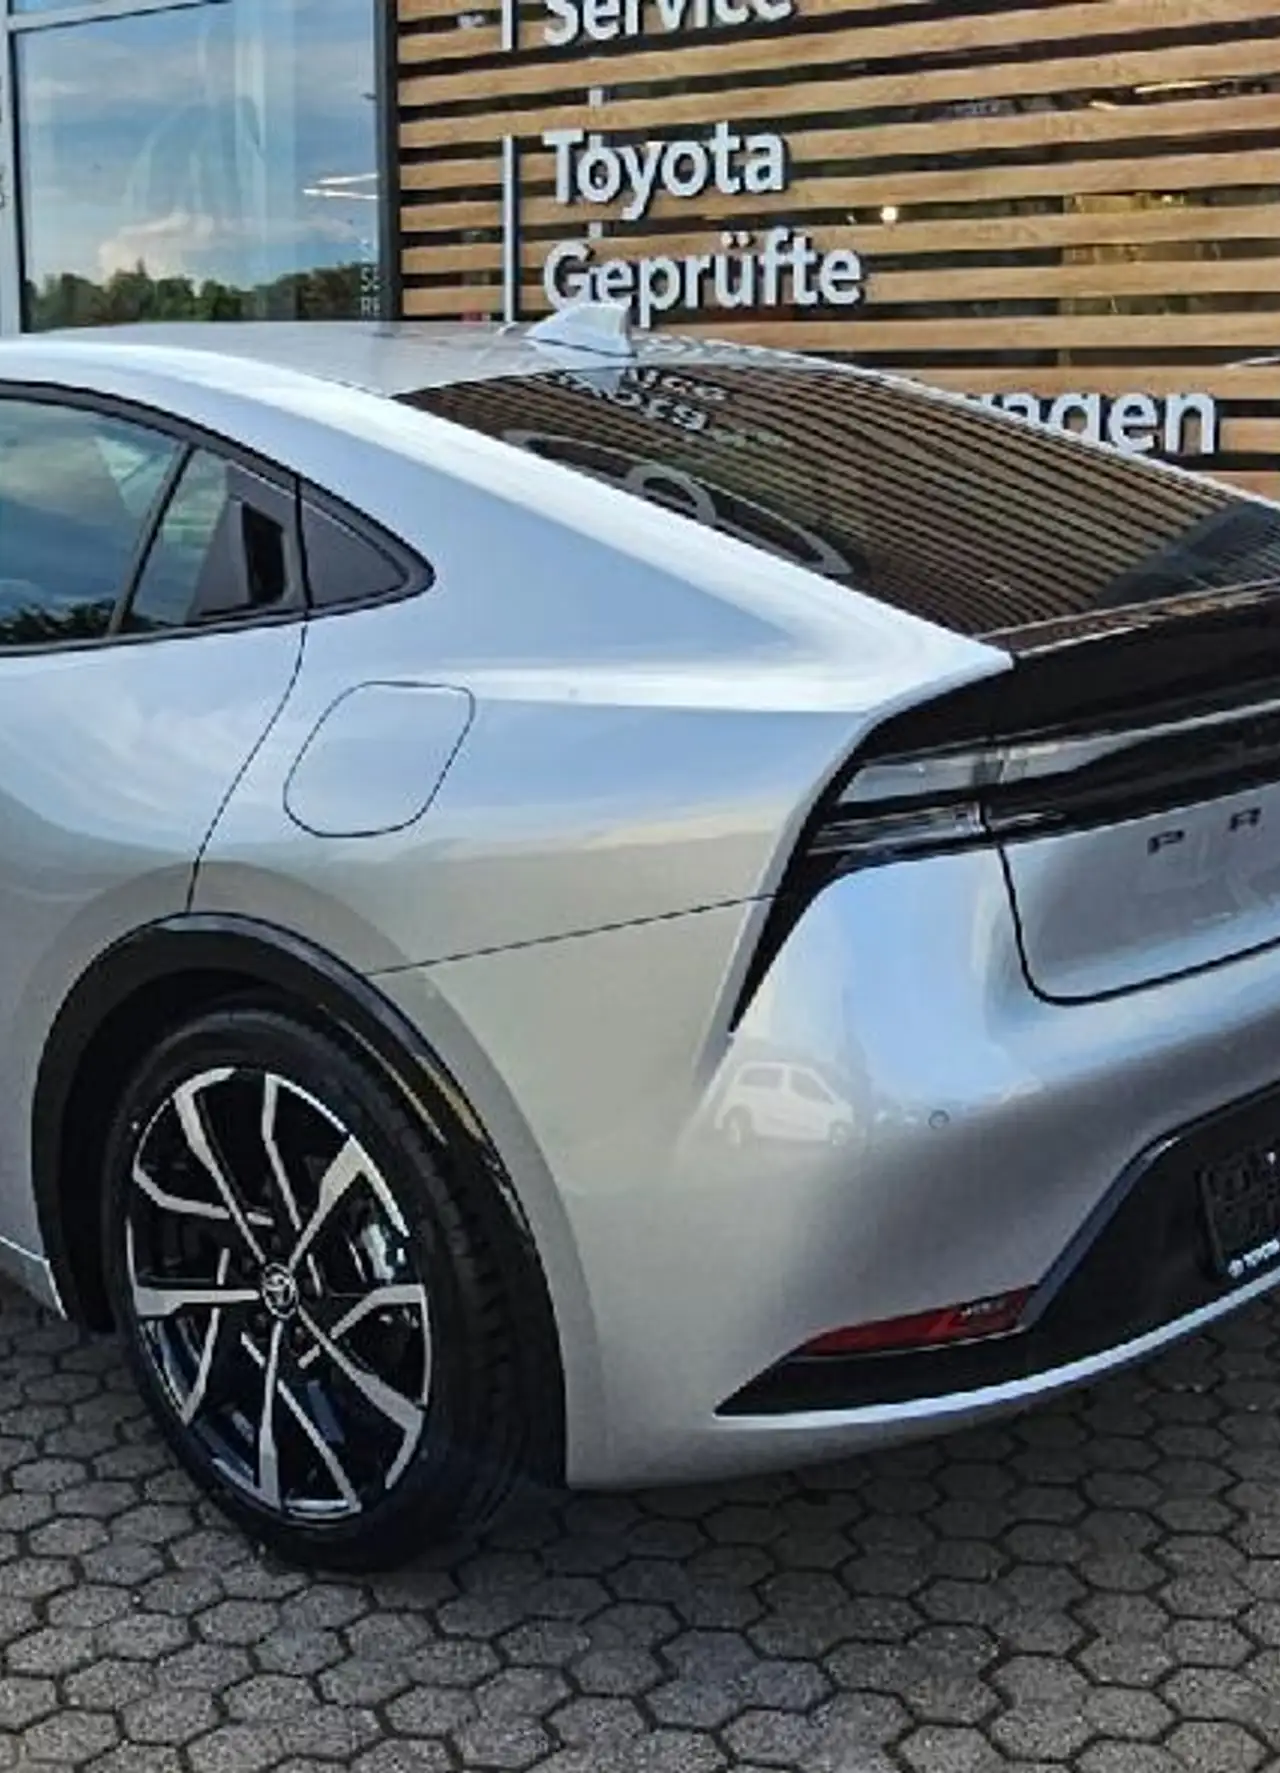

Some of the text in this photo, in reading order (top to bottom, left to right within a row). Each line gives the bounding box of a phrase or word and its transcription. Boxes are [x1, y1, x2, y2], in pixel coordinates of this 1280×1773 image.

[541, 120, 786, 222] Toyota
[542, 225, 863, 325] Geprüfte
[974, 391, 1217, 455] agen
